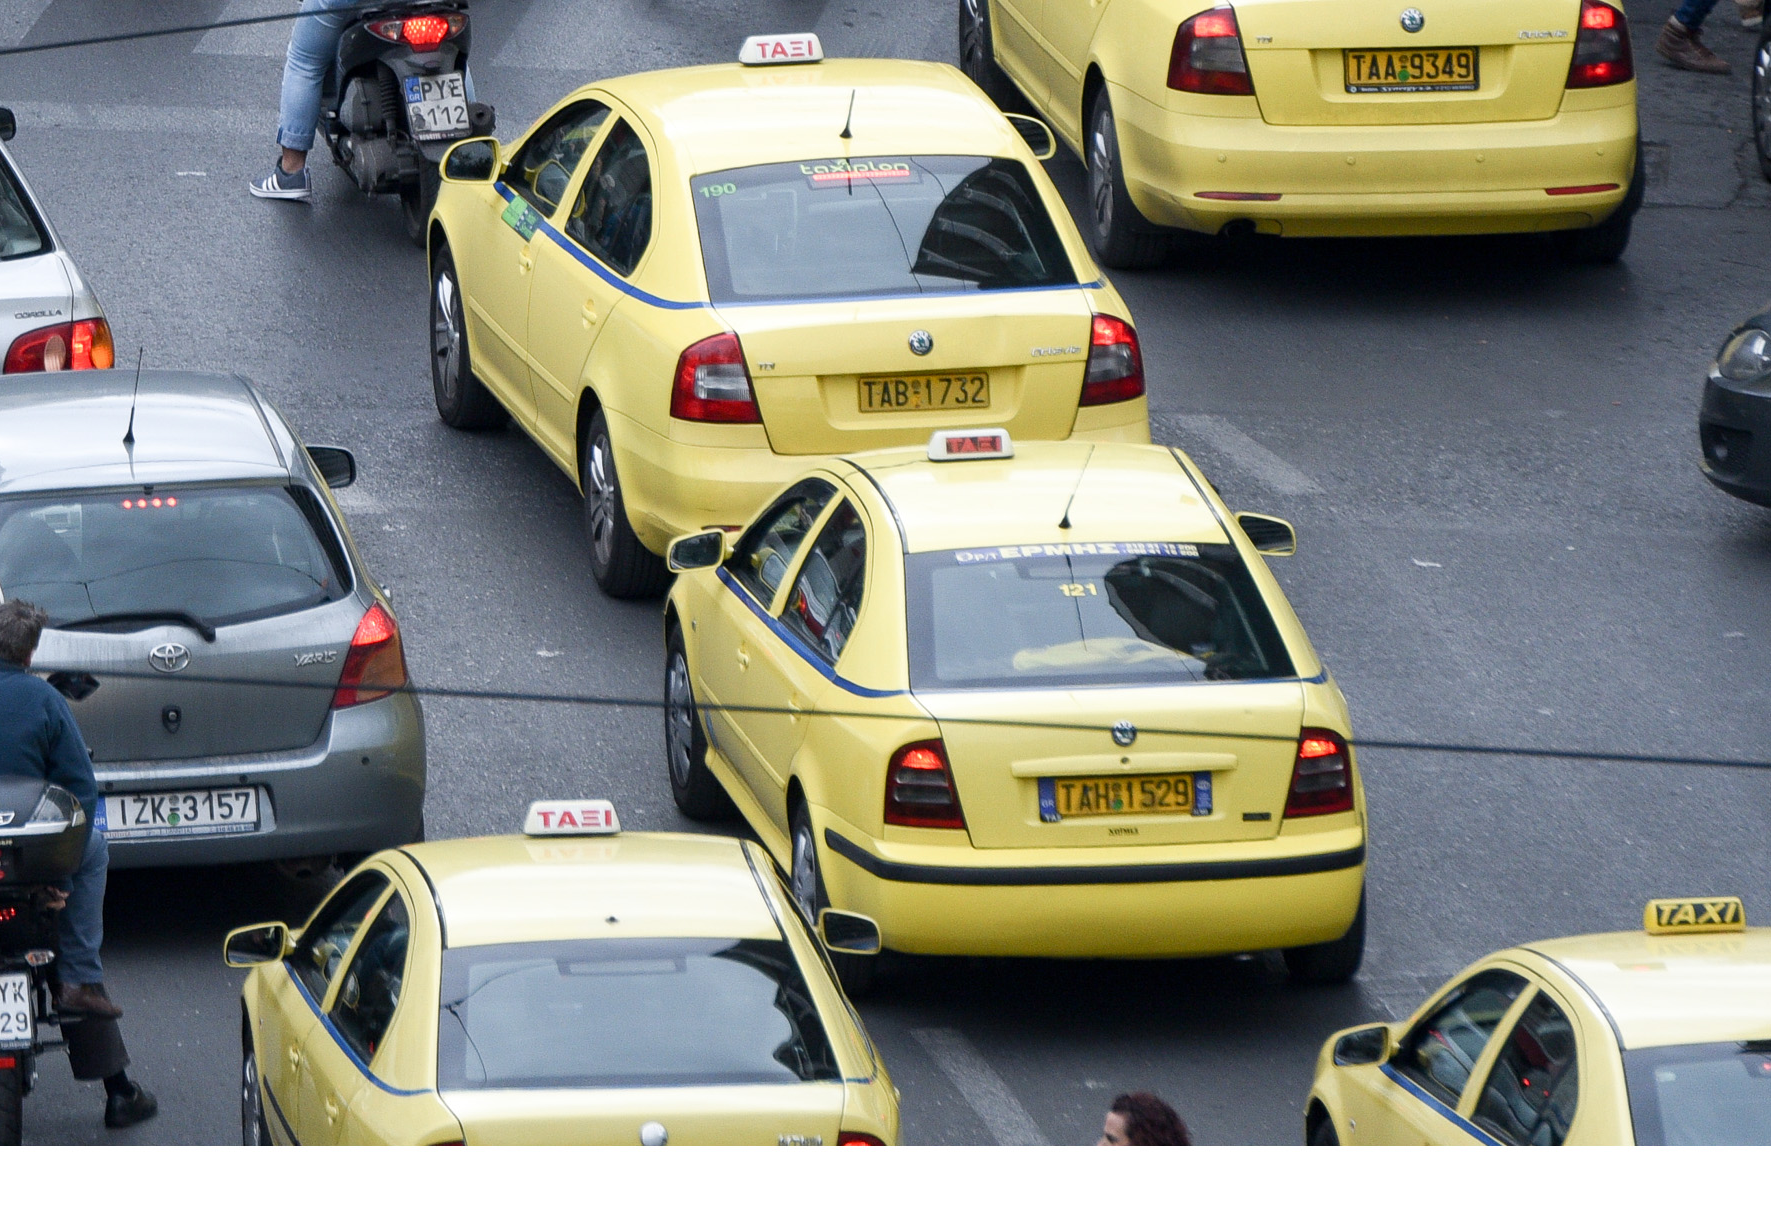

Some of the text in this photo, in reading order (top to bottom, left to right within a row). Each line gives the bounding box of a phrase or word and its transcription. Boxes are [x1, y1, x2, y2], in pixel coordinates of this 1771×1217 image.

[427, 105, 467, 126] 112
[699, 182, 737, 199] 190
[14, 308, 63, 319] COROLLA
[1059, 583, 1097, 597] 121
[293, 651, 337, 666] YARIS
[1658, 903, 1738, 925] TAXI
